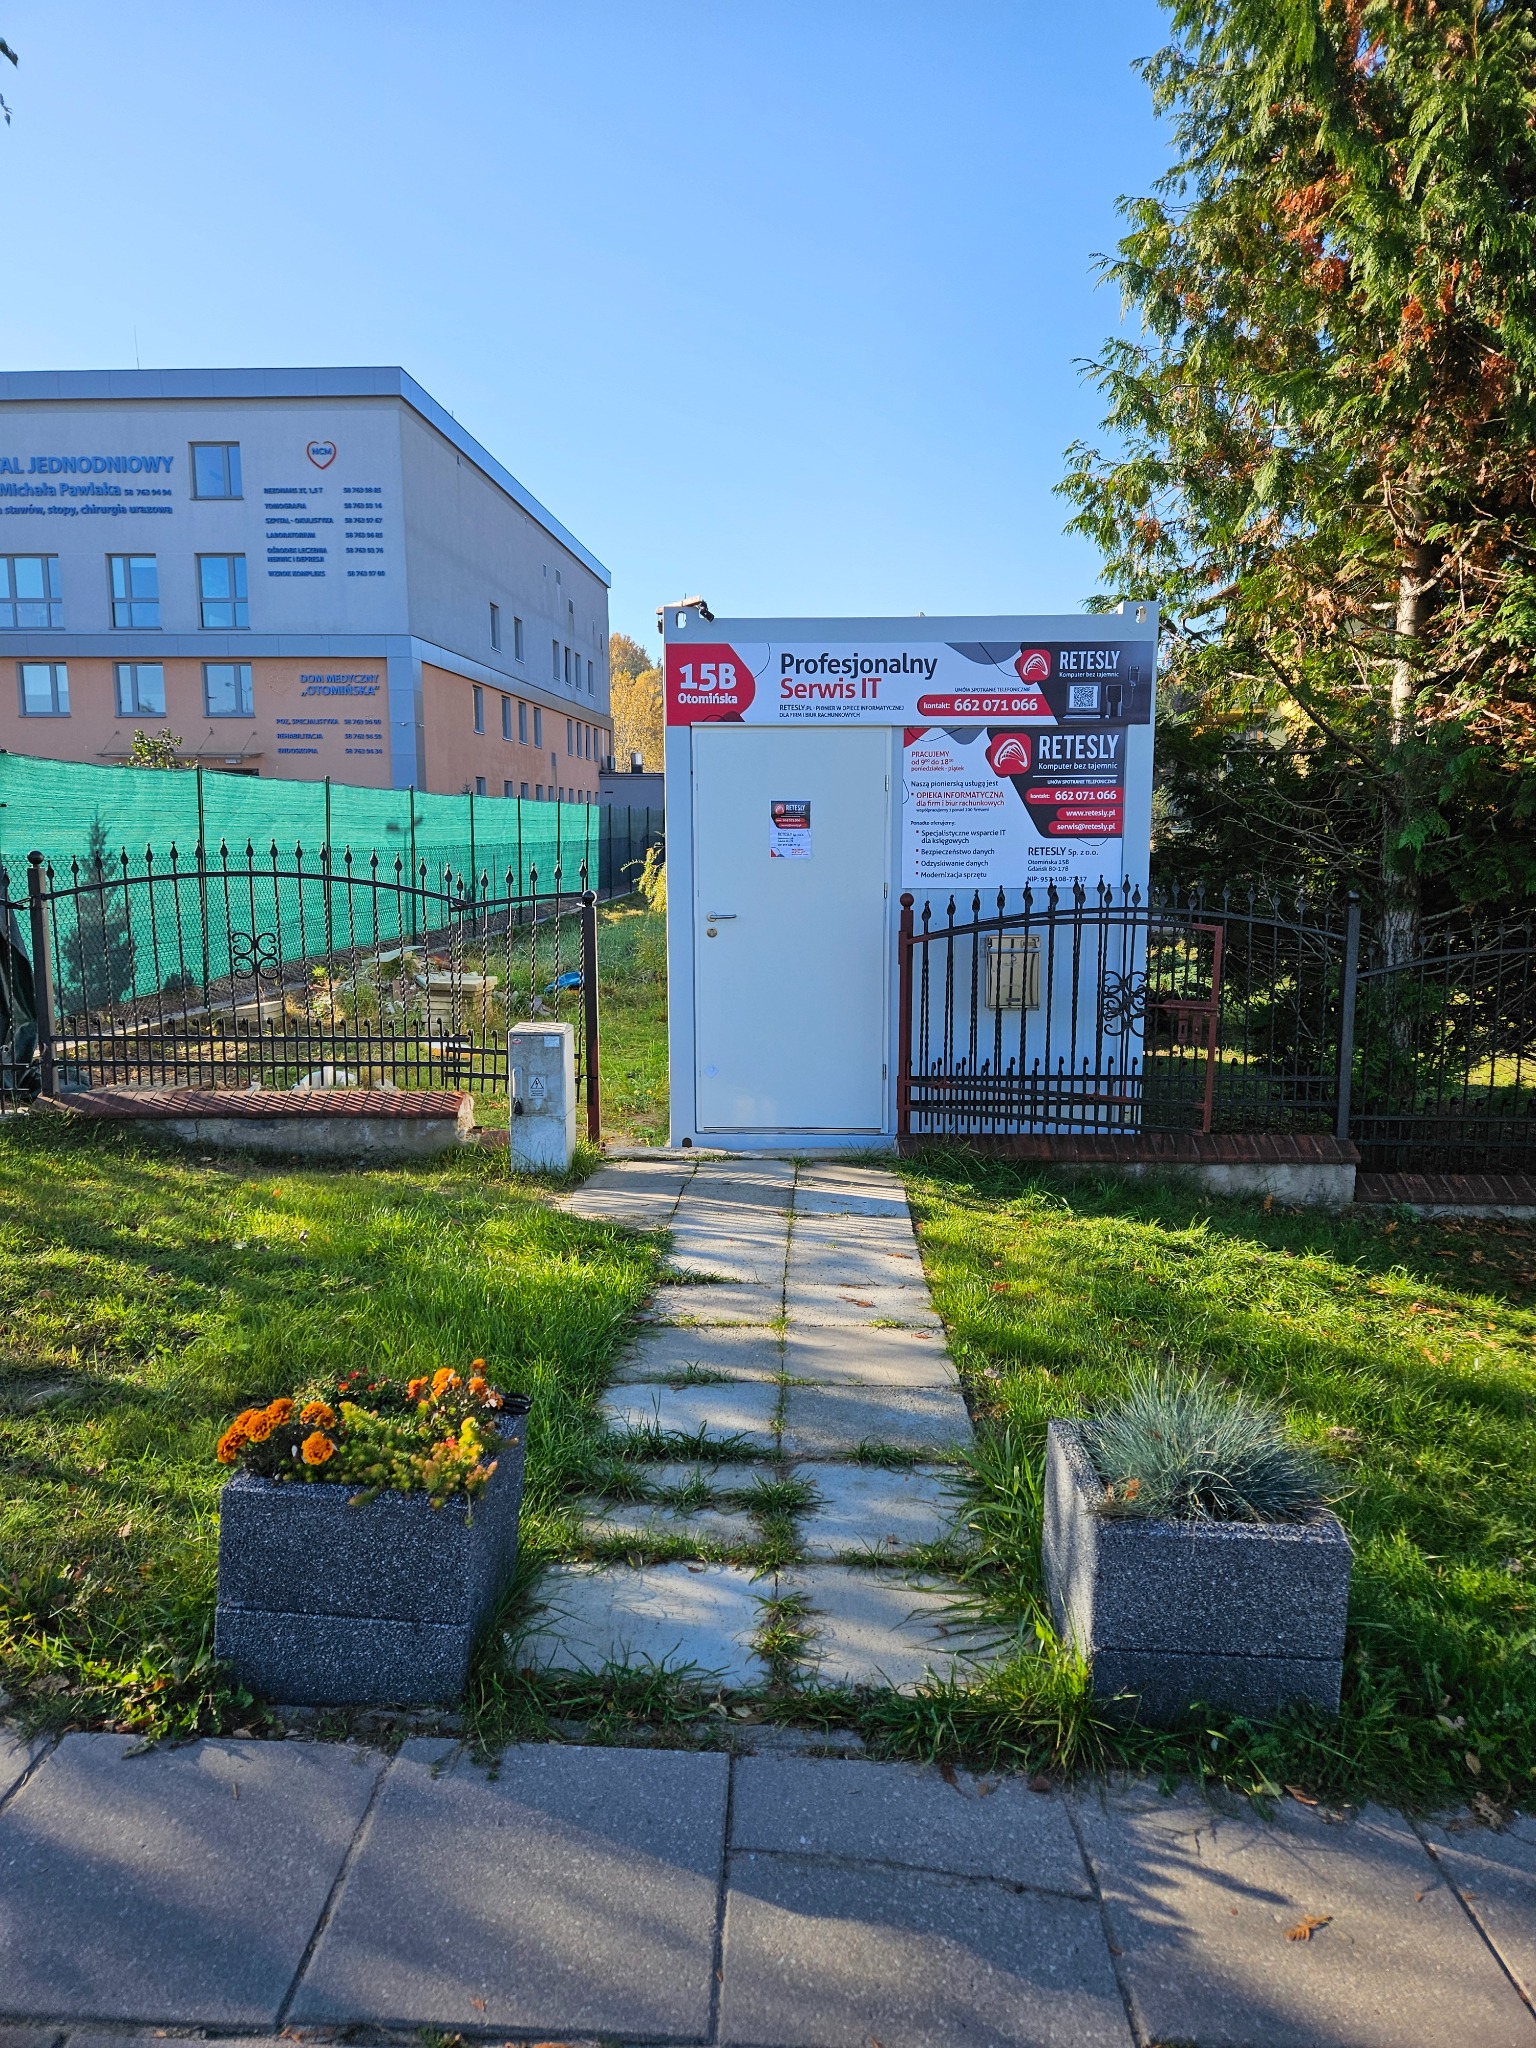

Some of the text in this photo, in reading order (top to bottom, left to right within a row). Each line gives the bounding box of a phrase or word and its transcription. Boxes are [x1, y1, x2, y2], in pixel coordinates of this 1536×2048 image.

[0, 456, 174, 474] AL JEDNODNIOWY
[0, 482, 56, 497] Michała
[59, 482, 121, 497] Pawlaka
[5, 504, 45, 516] stawów,
[47, 505, 79, 517] stopy,
[80, 504, 127, 516] chirurgia
[129, 506, 173, 514] urazowa
[1059, 650, 1121, 670] RETESLY
[780, 652, 938, 680] Profesjonalny
[300, 674, 380, 684] DOM MEDYCZNY
[679, 663, 737, 691] 15B
[1059, 671, 1084, 679] Komputer
[780, 677, 882, 699] Serwis IT
[677, 693, 738, 705] Otomińska
[923, 698, 1038, 712] kontakt: 662 071 066
[1038, 734, 1120, 759] RETESLY
[1038, 762, 1118, 771] Komputer bez tajemnic
[1055, 791, 1074, 800] 662
[1076, 791, 1095, 800] 071
[1097, 790, 1117, 800] 066
[1065, 809, 1116, 818] www.retesly.pl
[1057, 823, 1116, 831] serwis@retesly.pl
[971, 829, 998, 837] wsparcie
[921, 848, 995, 856] Bezpieczeństwo danych
[1028, 847, 1066, 856] RETESLY
[1068, 849, 1079, 857] Sp.
[921, 860, 964, 868] Odzyskiwanie
